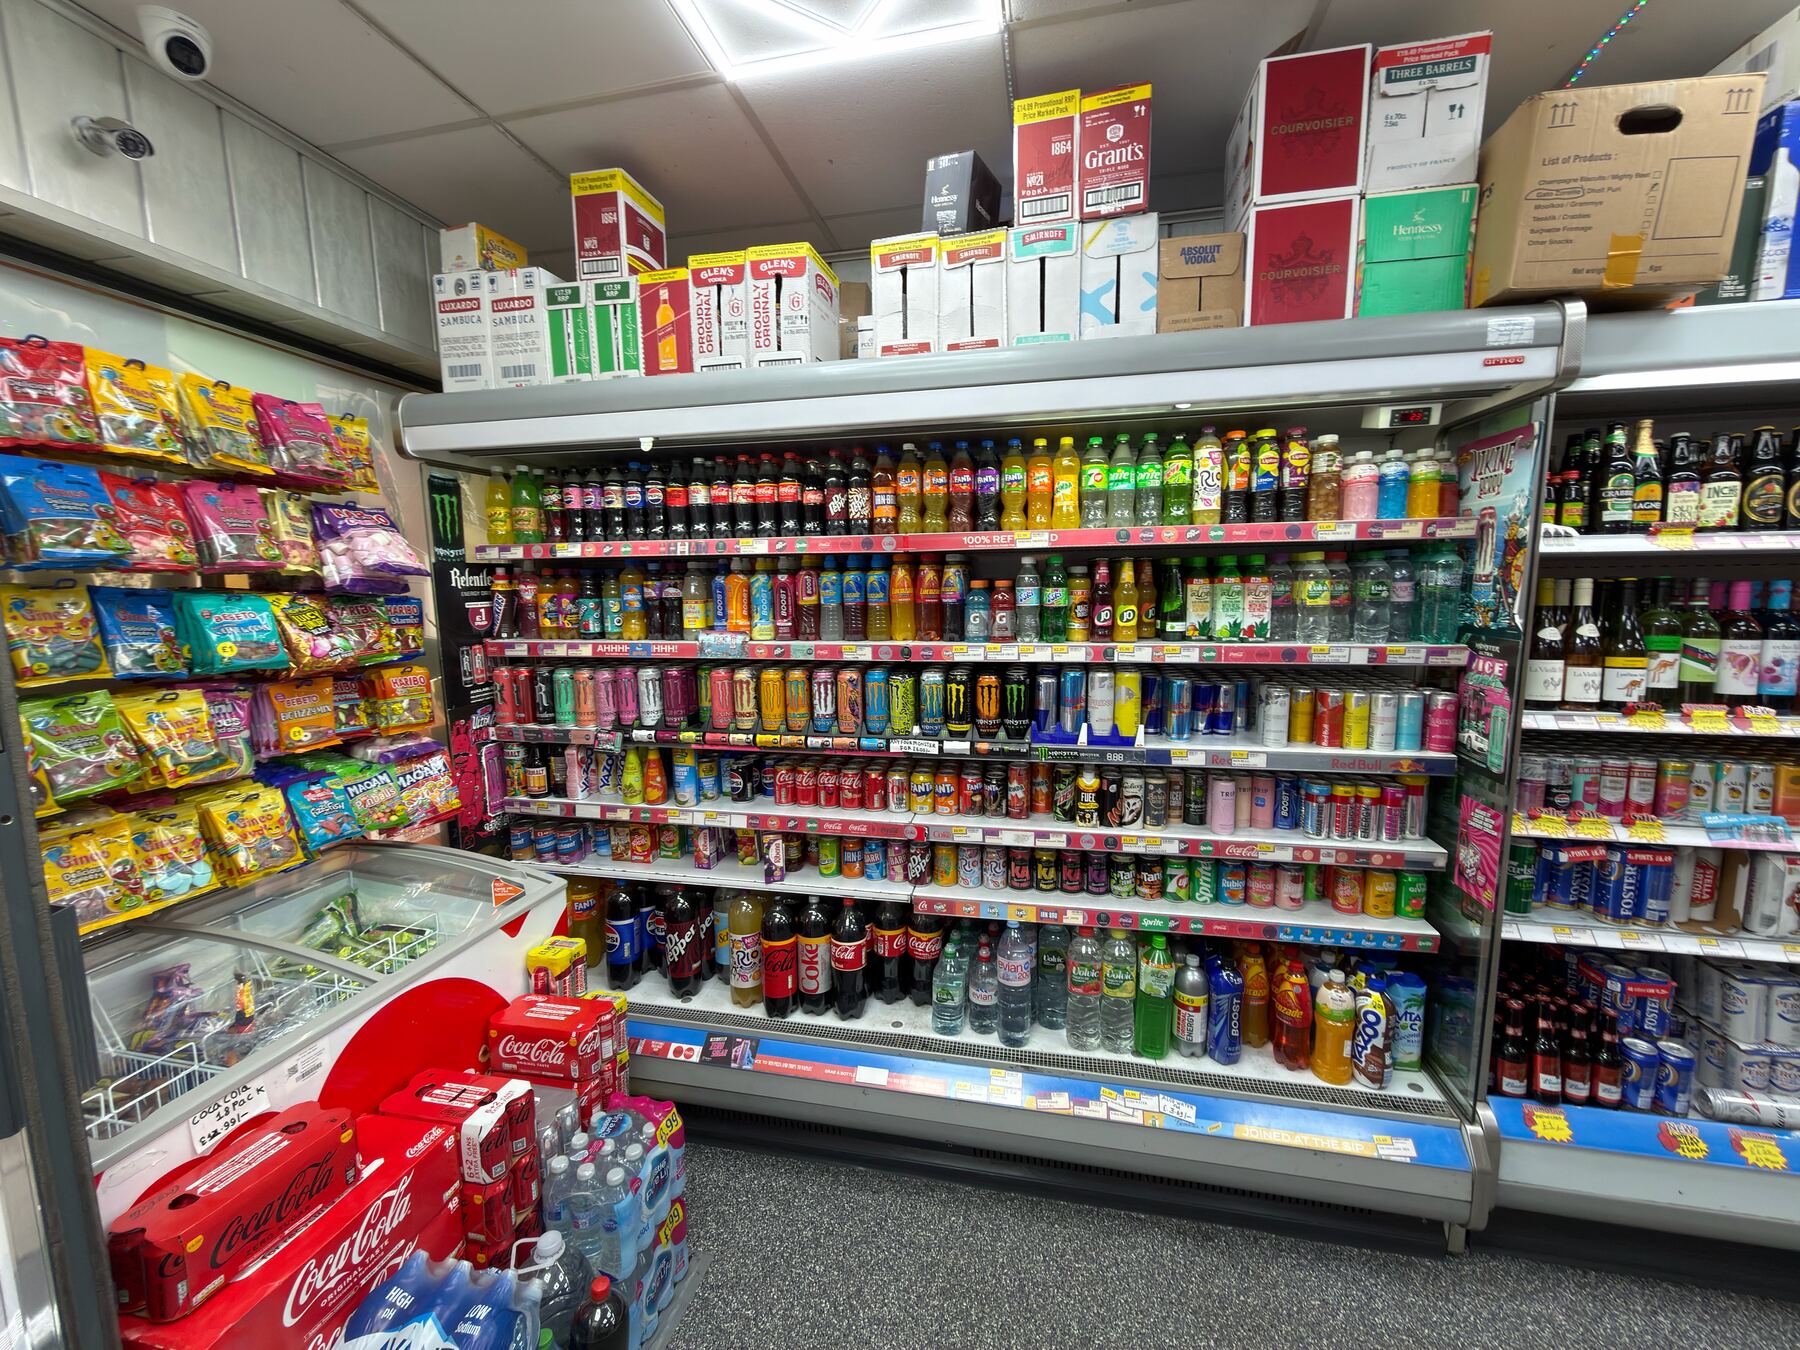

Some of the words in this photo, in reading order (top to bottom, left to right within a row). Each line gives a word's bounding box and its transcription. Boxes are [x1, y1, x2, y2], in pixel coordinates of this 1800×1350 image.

[1417, 44, 1452, 54] Promotional
[1453, 40, 1468, 50] RRP
[1403, 55, 1418, 63] Price
[1420, 52, 1440, 61] Marked
[1443, 50, 1459, 58] Pack
[1390, 67, 1423, 80] THREE
[1426, 60, 1471, 75] BARRELS
[1034, 98, 1063, 108] Promotional
[1065, 95, 1075, 103] RRP
[1037, 109, 1055, 117] Marked
[1271, 116, 1355, 136] COURVOISIER
[1052, 140, 1072, 155] 1864
[1085, 142, 1144, 169] Grant's
[1542, 158, 1559, 166] List
[1561, 156, 1571, 164] of
[1573, 153, 1612, 163] Products
[1386, 162, 1417, 171] PRODUCT
[1430, 157, 1456, 166] FRANCE
[1022, 188, 1048, 196] VODKA
[931, 194, 958, 204] Hennessy
[1024, 229, 1064, 243] SMIRNOFF
[1393, 223, 1444, 236] Hennessy
[959, 249, 990, 259] SMIRNOFF
[1180, 244, 1222, 257] ABSOLUT
[891, 253, 920, 262] SMIRNOFF
[1184, 253, 1217, 265] VODKA
[759, 259, 796, 272] GLEN'S
[700, 267, 734, 279] GLEN'S
[1260, 265, 1341, 281] COURVOISIER
[441, 301, 479, 311] LUXARDO
[494, 299, 532, 310] LUXARDO
[440, 315, 482, 327] SAMBUCA
[493, 315, 535, 326] SAMBUCA
[706, 290, 714, 353] ORIGINAL
[753, 284, 763, 349] PROUDLY
[763, 283, 771, 348] ORIGINAL
[695, 292, 706, 354] PROUDLY
[954, 475, 972, 484] FANTA
[977, 475, 996, 484] FANTA
[1005, 472, 1022, 482] FANTA
[962, 535, 990, 544] 100%
[450, 567, 491, 588] Relentle
[387, 605, 418, 615] HARIBO
[476, 608, 485, 621] £1
[493, 594, 505, 633] SNICKERS
[391, 615, 419, 624] Starmix
[970, 613, 980, 624] G
[996, 613, 1006, 624] G
[1475, 643, 1500, 653] MONSTER
[392, 675, 426, 688] HARIBO
[285, 695, 319, 707] BEBETO
[292, 729, 303, 738] £1
[398, 756, 448, 789] MAOAM
[347, 772, 391, 797] MAOAM
[911, 783, 933, 792] FANTA
[355, 785, 397, 809] Pinballs
[1081, 792, 1095, 802] FUEL
[1281, 791, 1289, 817] BOOST
[823, 822, 842, 830] Coca-Cola
[849, 824, 867, 832] Coca-Cola
[1360, 805, 1370, 839] ENERGY
[1225, 845, 1258, 856] Coca-Cola
[912, 856, 921, 864] Dr
[1194, 861, 1212, 904] Sprite
[1691, 868, 1702, 900] ARTOIS
[1701, 867, 1714, 900] STELLA
[574, 899, 597, 912] FANTA
[1142, 918, 1163, 927] Sprite
[667, 931, 680, 947] Dr
[908, 936, 942, 952] Coca-Cola
[1043, 955, 1064, 964] Volvic
[802, 944, 820, 992] Coke
[998, 961, 1023, 973] evian
[1072, 968, 1099, 977] Volvic
[1106, 971, 1133, 979] Volvic
[972, 993, 992, 1001] evian
[1177, 995, 1195, 1005] £1.49
[1231, 998, 1240, 1037] BOOST
[1396, 1011, 1422, 1022] VITA
[1355, 1010, 1381, 1064] YAZOO
[498, 1033, 566, 1067] Coca-Cola
[216, 1108, 231, 1122] 18
[406, 1126, 446, 1158] Coca-Cola
[443, 1135, 455, 1150] 18
[1242, 1128, 1290, 1142] JOINED
[1292, 1134, 1310, 1146] AT
[1312, 1137, 1340, 1150] THE
[1342, 1142, 1364, 1152] SIP
[466, 1163, 474, 1182] 6+2
[209, 1151, 334, 1269] Coca-Cola
[448, 1197, 459, 1212] 18
[245, 1234, 275, 1257] ZERO
[282, 1169, 415, 1328] Coca-Cola
[321, 1267, 363, 1307] ORIGINAL
[365, 1239, 389, 1263] TASTE
[385, 1286, 415, 1309] HIGH
[465, 1304, 491, 1319] LOW
[454, 1321, 481, 1335] Sodium
